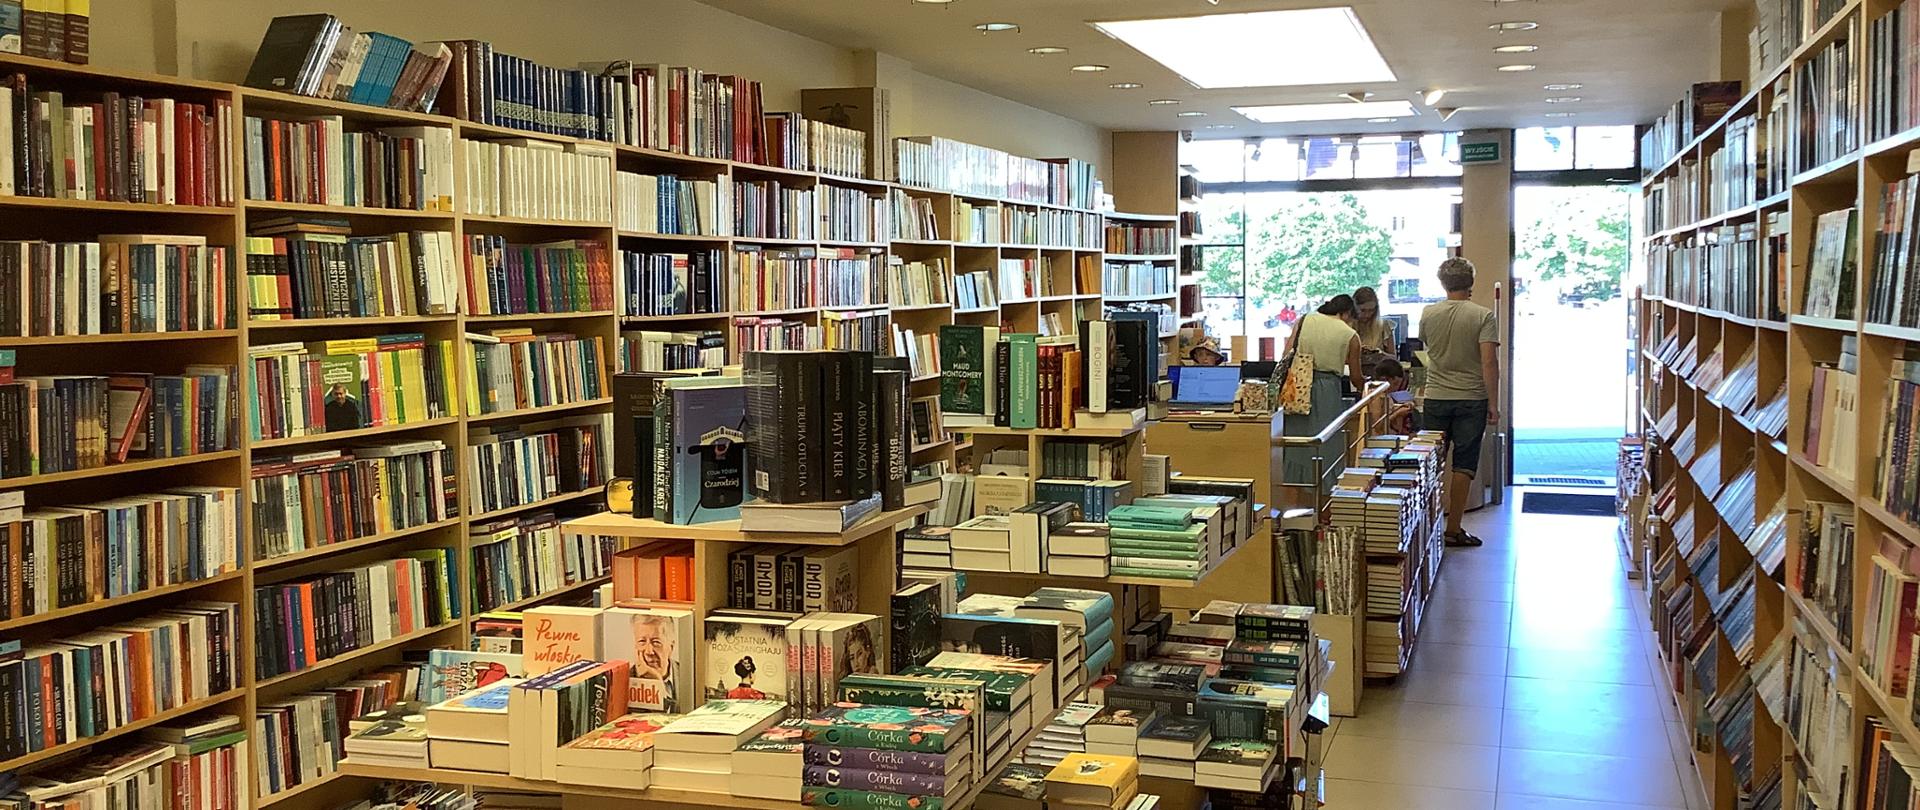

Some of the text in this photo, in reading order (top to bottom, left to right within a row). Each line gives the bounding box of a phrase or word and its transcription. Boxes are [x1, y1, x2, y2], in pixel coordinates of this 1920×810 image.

[330, 260, 340, 300] MISTYCZKI
[338, 260, 349, 300] MISTYCZKI
[942, 370, 982, 379] MONTGOMERY
[953, 362, 970, 370] MAUD
[999, 346, 1008, 384] Miss Dior
[1094, 346, 1102, 381] BOGINI
[797, 405, 806, 487] TRUPIA OTUCHA
[831, 412, 843, 478] PIĄTY KIER
[857, 400, 867, 480] ABOMINACJA
[656, 447, 665, 487] NAJDALSZE
[889, 438, 900, 481] BRAZOS
[373, 462, 381, 501] TALENTY
[656, 486, 665, 510] KRESY
[704, 478, 740, 488] Czarodziej
[756, 561, 773, 597] AMOR
[806, 563, 822, 599] AMOR
[536, 618, 581, 642] Pewne
[726, 636, 767, 646] OSTATNIA
[534, 643, 582, 664] włoskie
[733, 644, 782, 656] SZANGHAJU
[33, 691, 42, 735] POKORA
[868, 730, 903, 743] Córka
[869, 751, 904, 764] Córka
[867, 771, 903, 785] Córka
[866, 793, 902, 807] Córka
